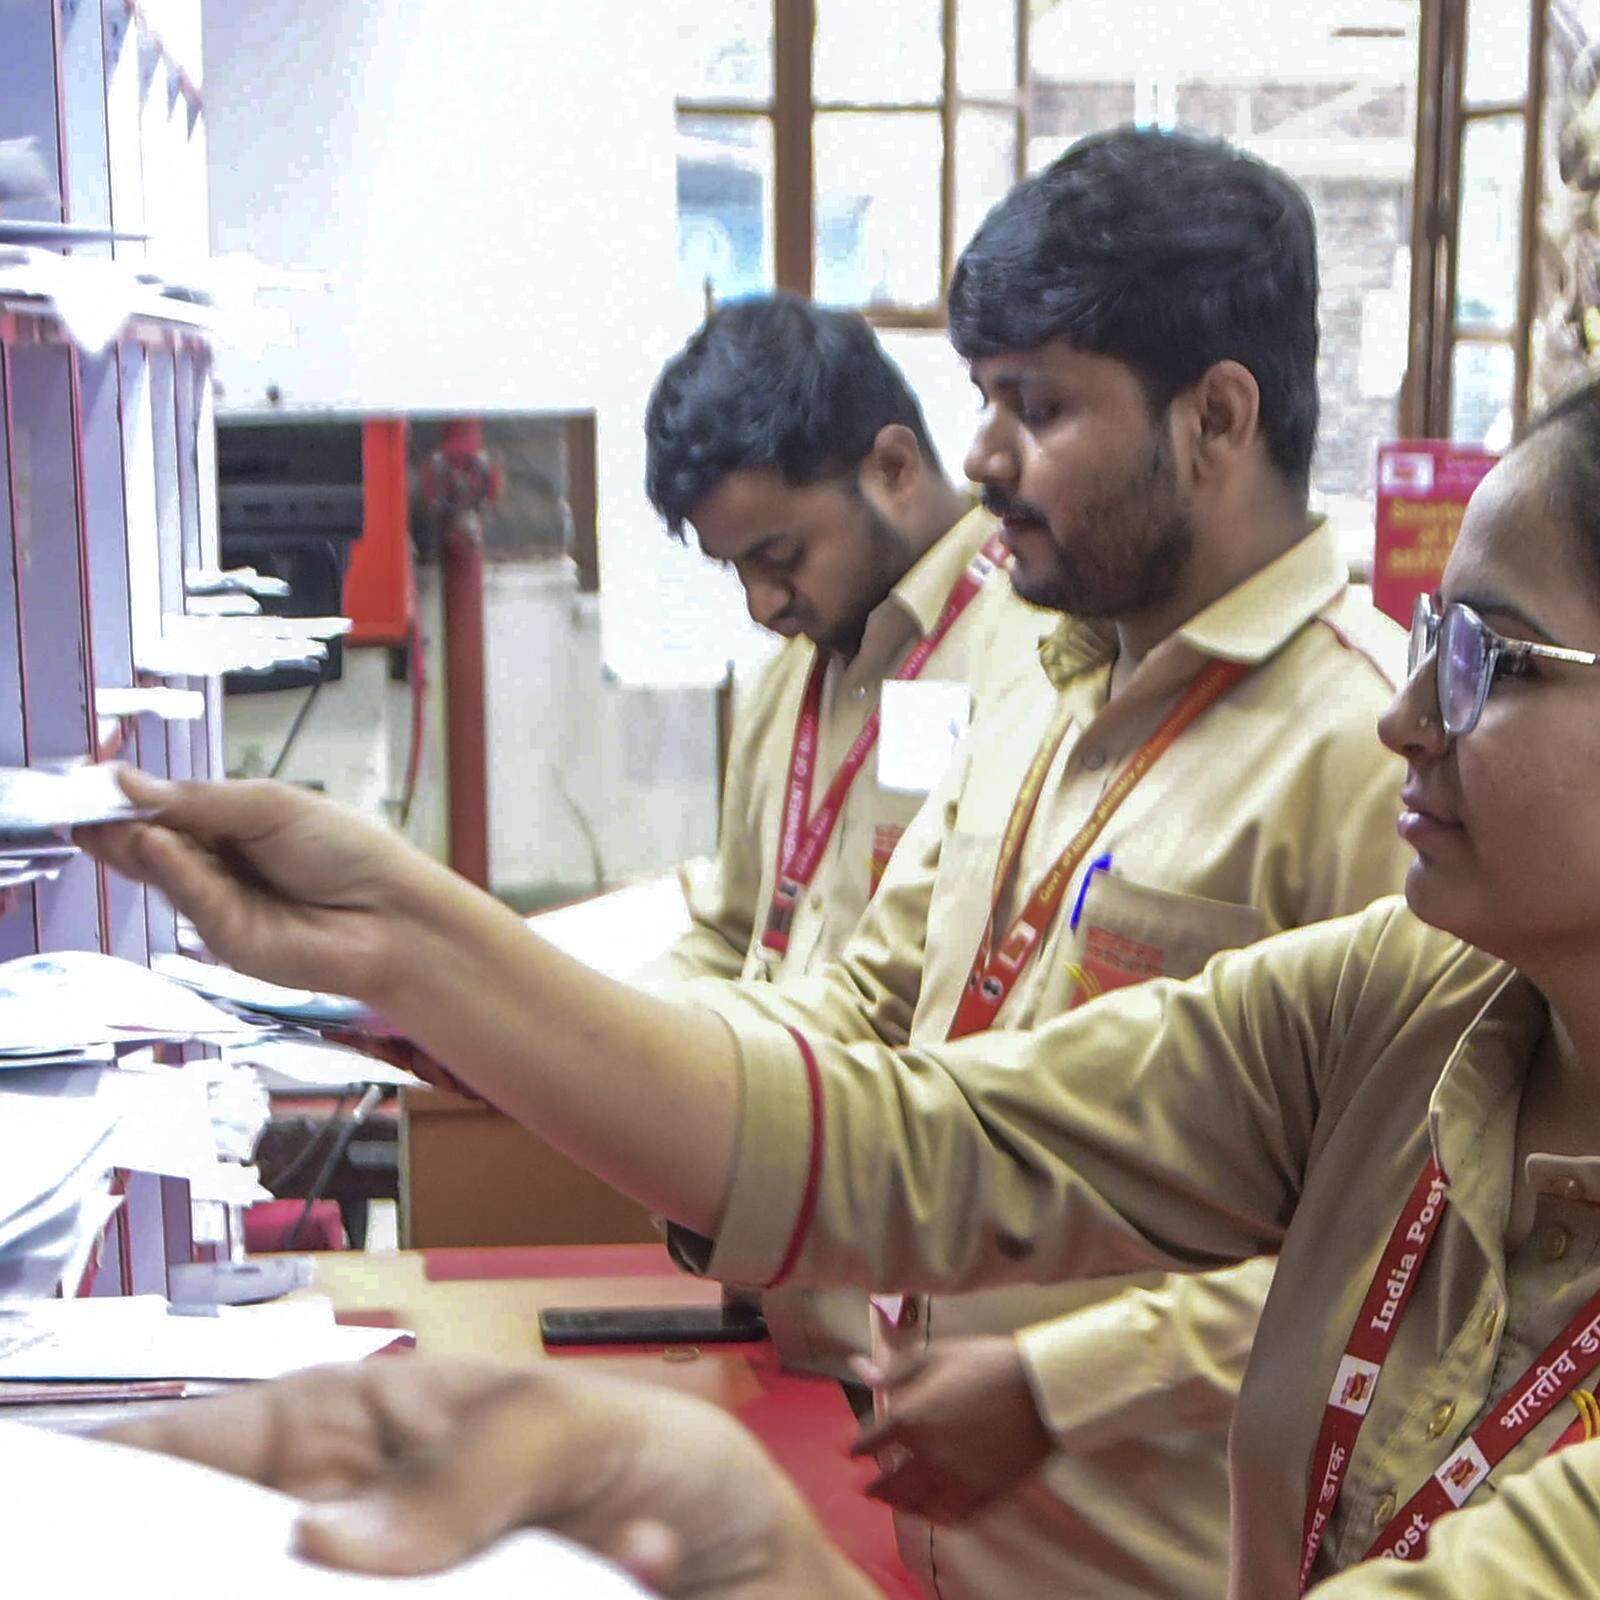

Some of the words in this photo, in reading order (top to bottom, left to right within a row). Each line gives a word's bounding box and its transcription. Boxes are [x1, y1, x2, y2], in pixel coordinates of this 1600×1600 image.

[1371, 1253, 1417, 1333] India
[1407, 1176, 1446, 1245] Post
[1501, 1349, 1577, 1428] भारतीय
[1319, 1441, 1345, 1503] डाक
